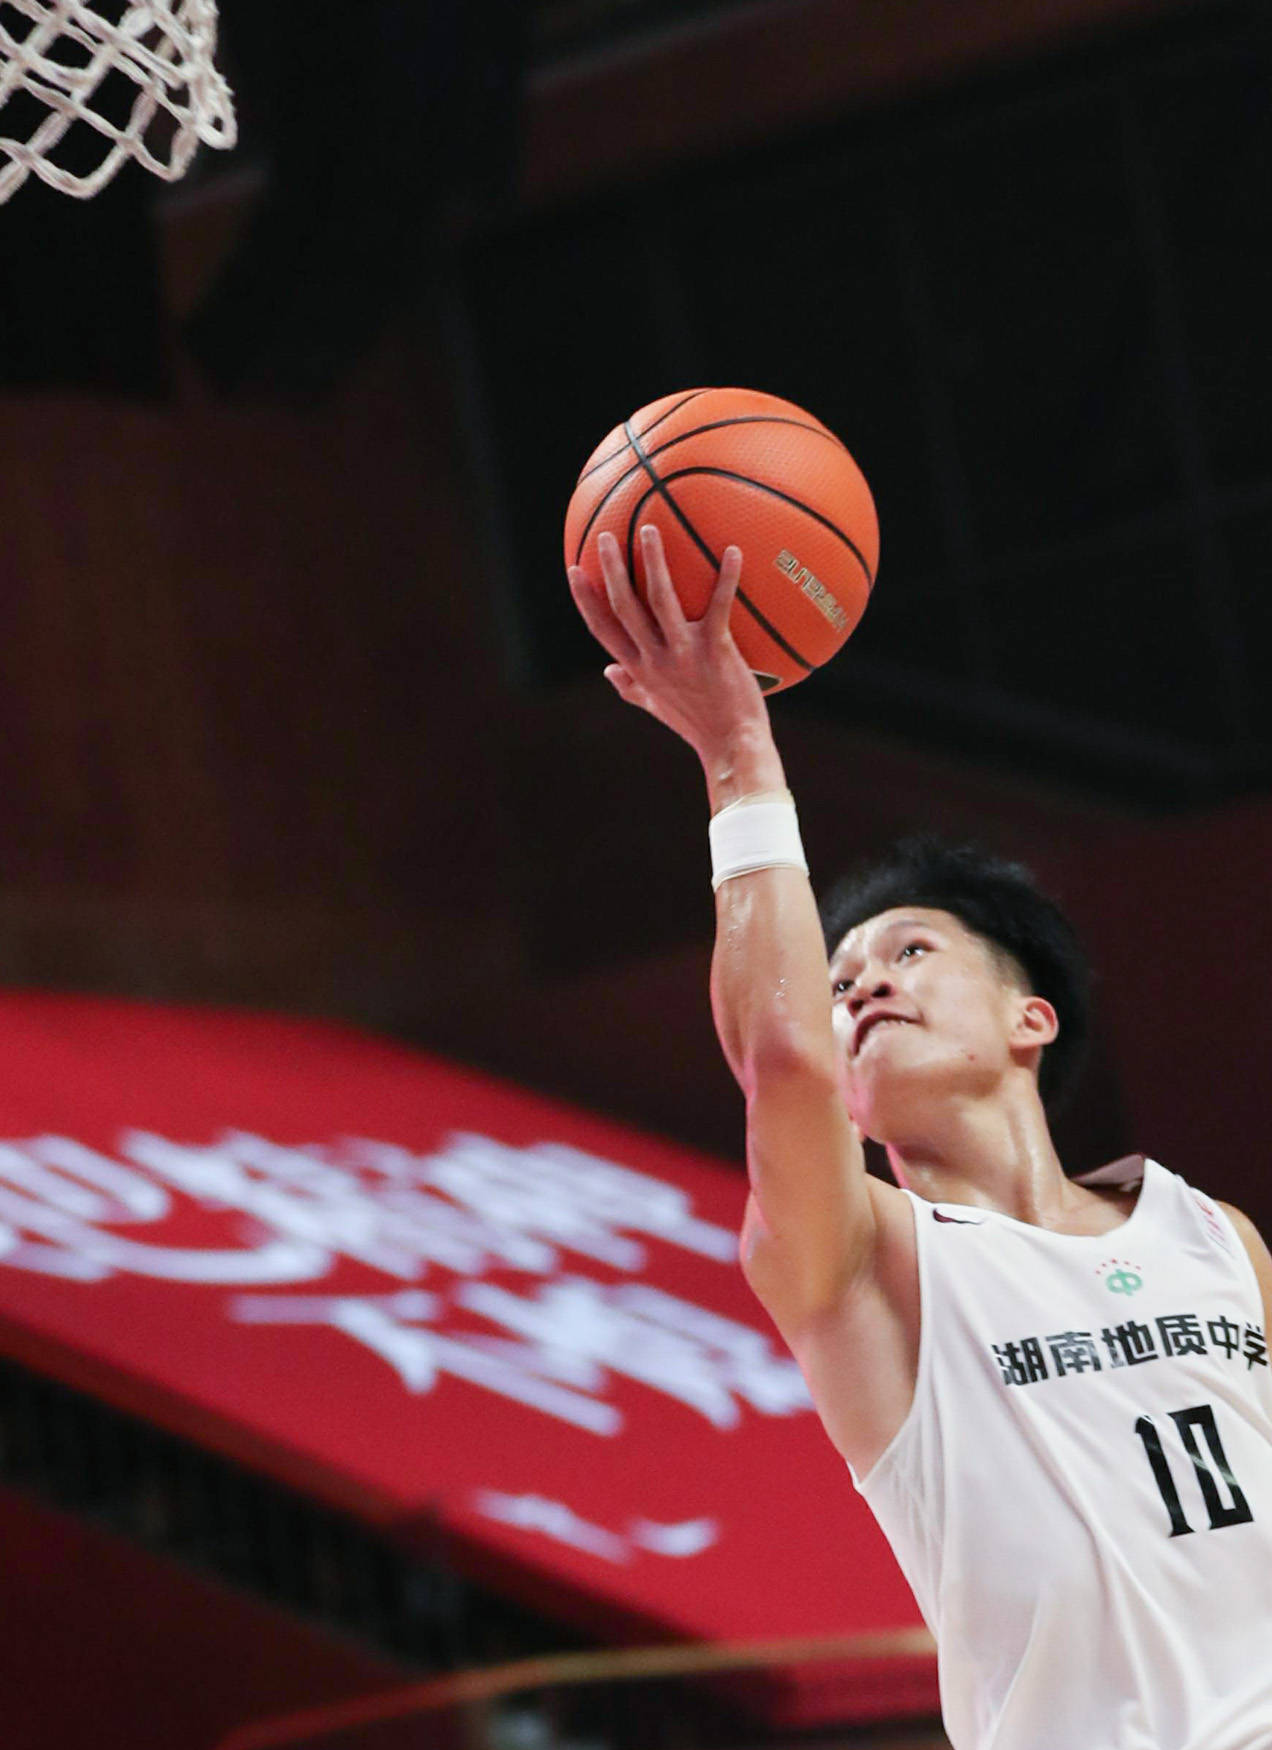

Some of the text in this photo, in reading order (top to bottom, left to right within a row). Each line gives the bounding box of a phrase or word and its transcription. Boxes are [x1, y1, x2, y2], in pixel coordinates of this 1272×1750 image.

[992, 1314, 1269, 1386] 湖南地质中学
[1134, 1404, 1255, 1538] 10
